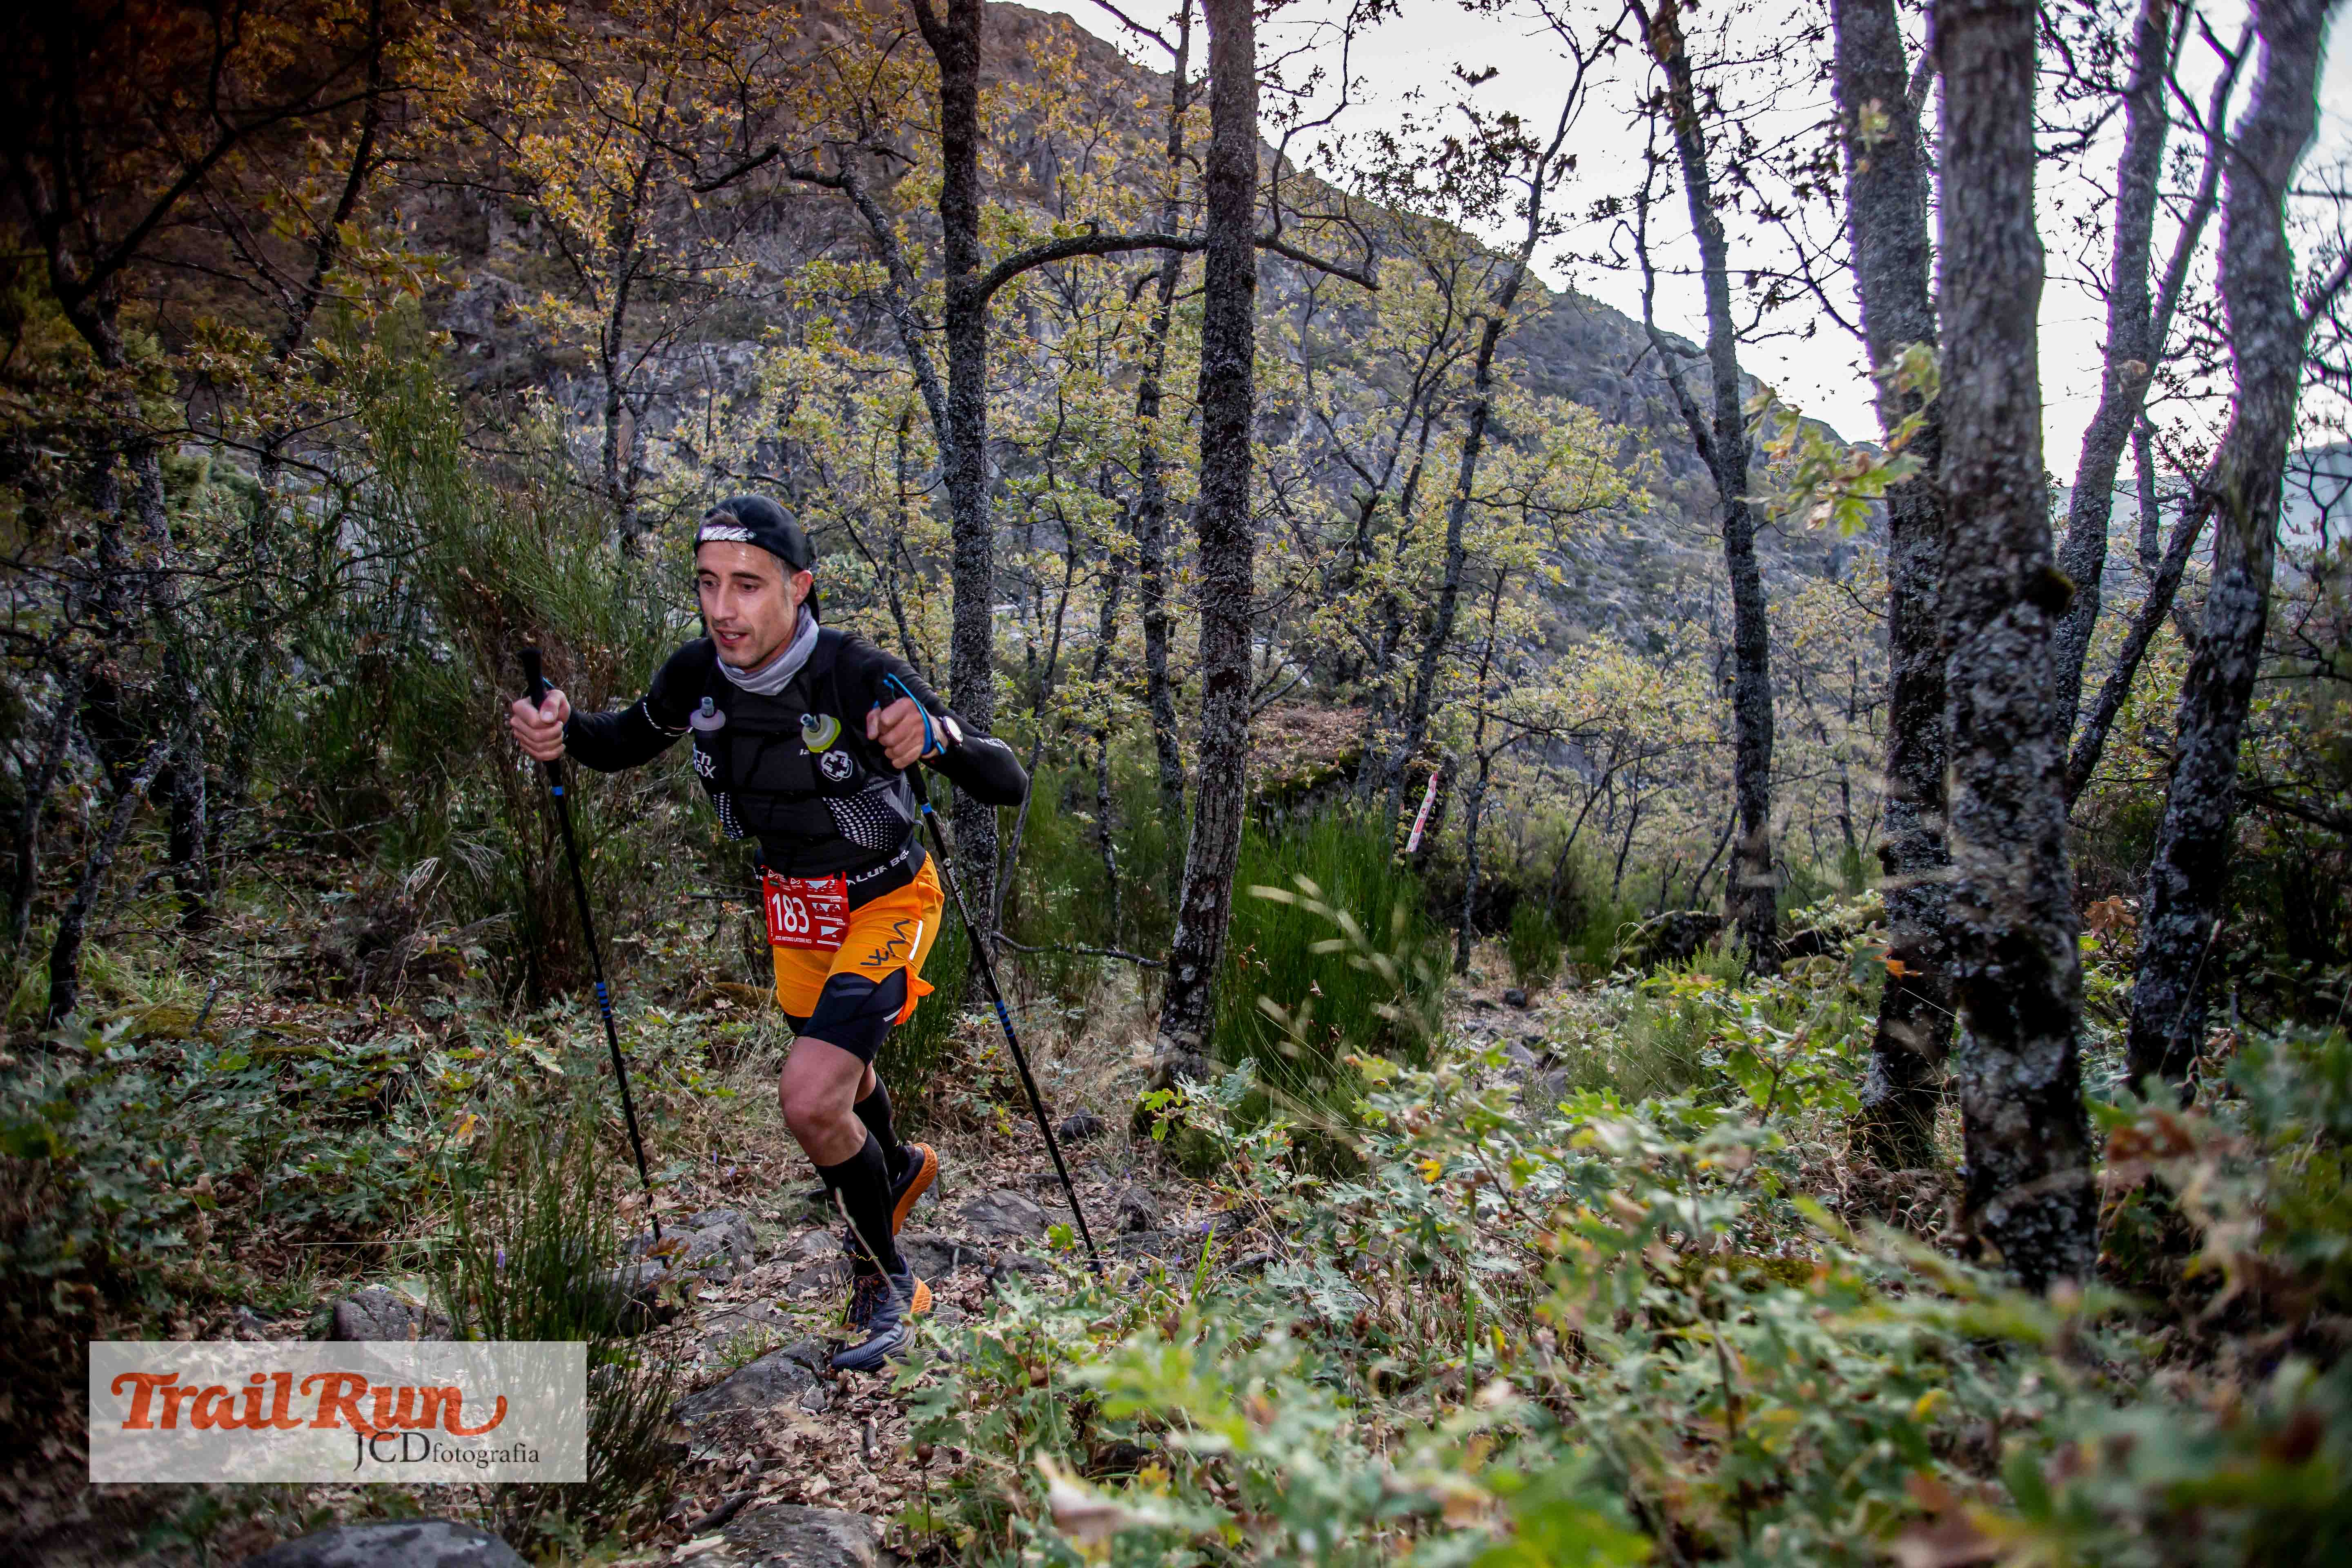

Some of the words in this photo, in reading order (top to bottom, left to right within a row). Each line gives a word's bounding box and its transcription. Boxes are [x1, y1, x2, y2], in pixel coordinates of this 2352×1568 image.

[772, 893, 809, 933] 183
[947, 867, 960, 891] Black
[956, 890, 974, 927] Diamond
